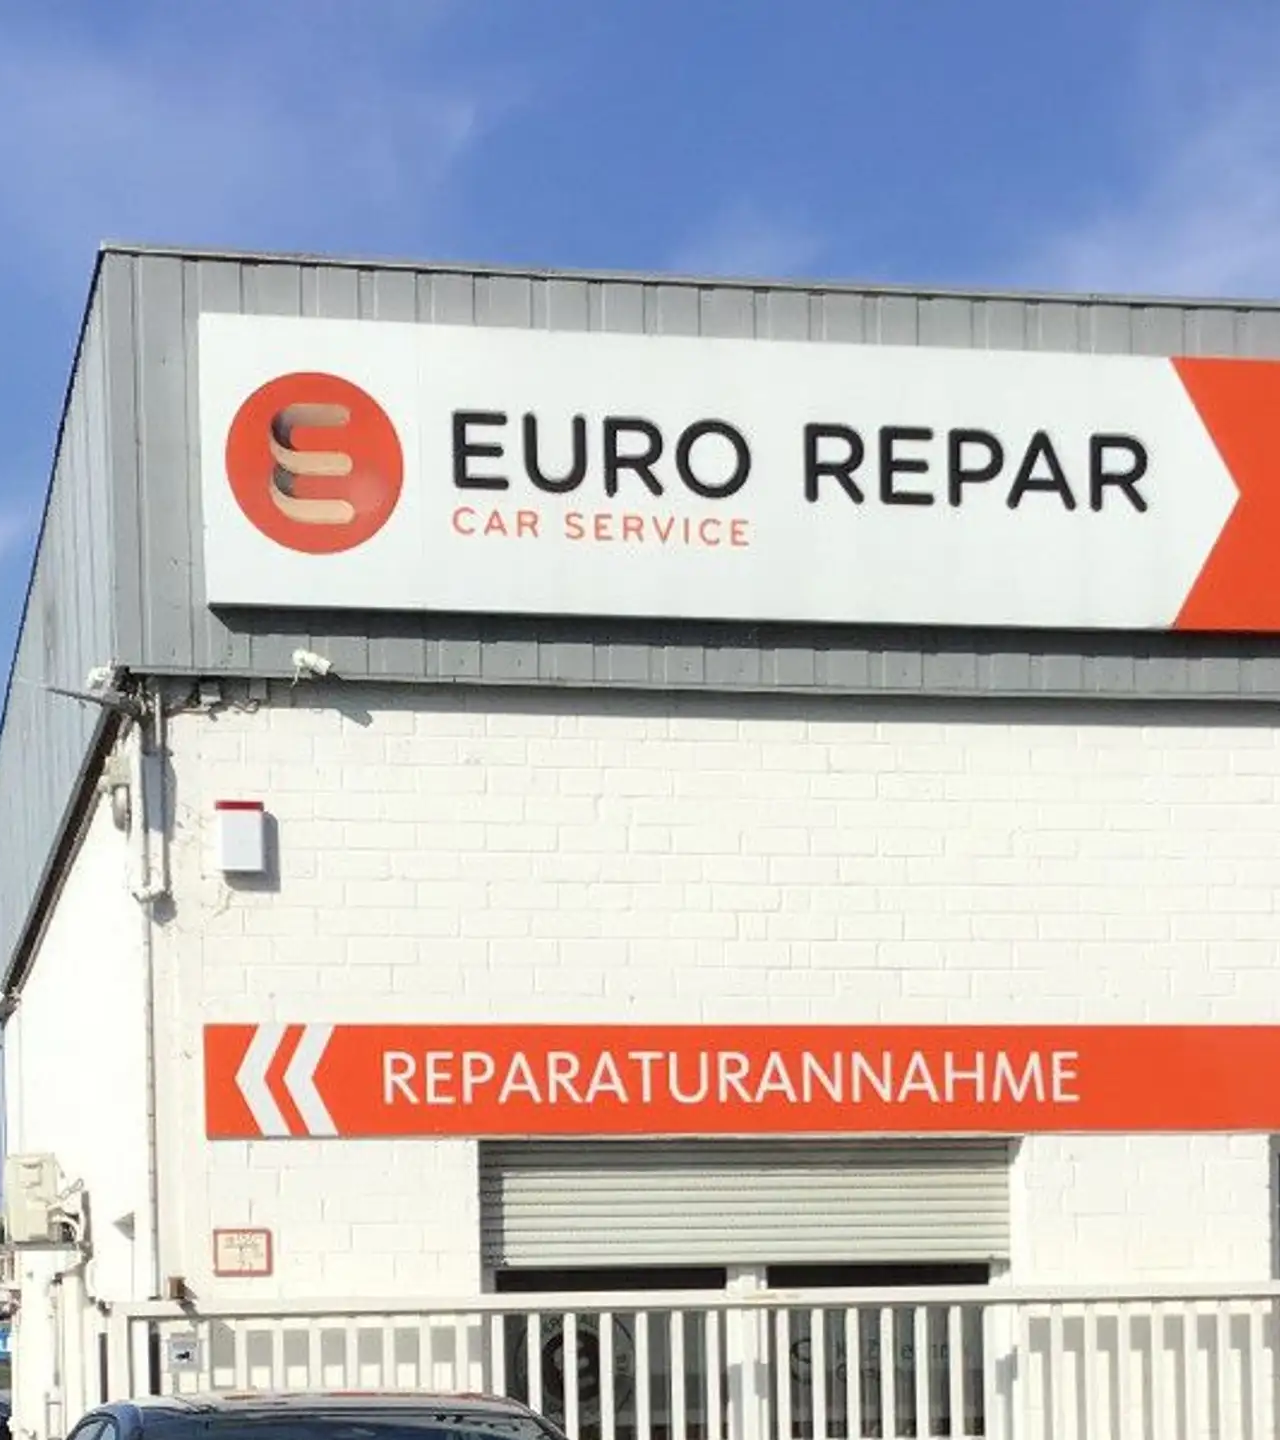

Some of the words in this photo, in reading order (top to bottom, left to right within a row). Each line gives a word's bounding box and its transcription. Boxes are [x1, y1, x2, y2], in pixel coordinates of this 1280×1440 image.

[453, 410, 752, 499] EURO
[805, 421, 1148, 513] REPAR
[451, 506, 540, 538] CAR
[565, 512, 751, 547] SERVICE
[383, 1051, 1079, 1104] REPARATURANNAHME
